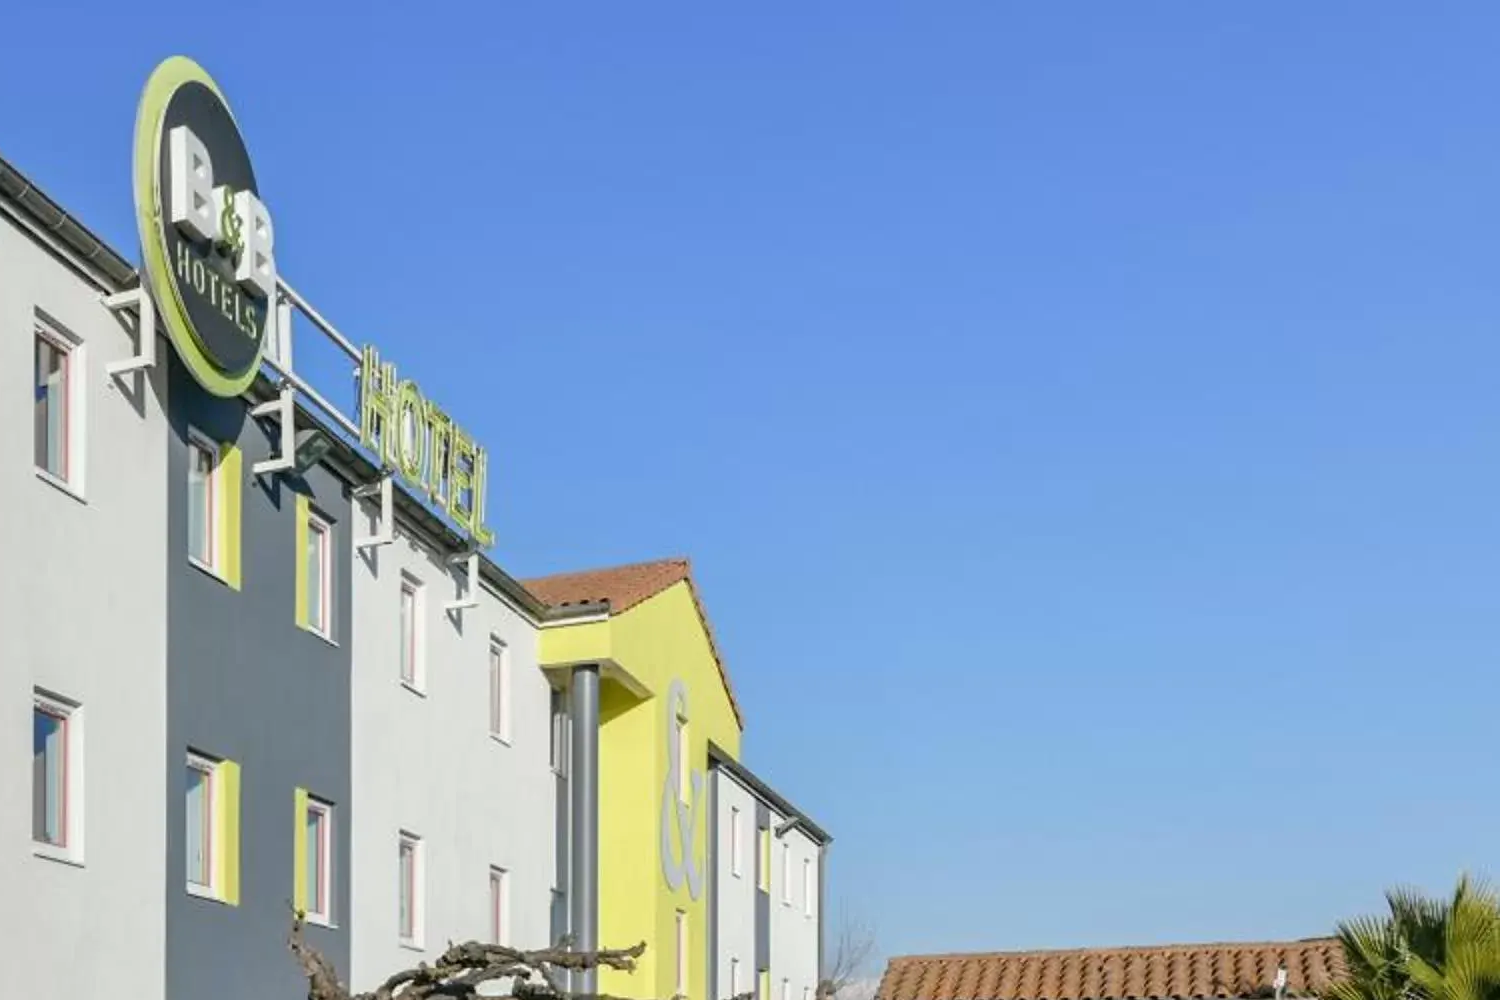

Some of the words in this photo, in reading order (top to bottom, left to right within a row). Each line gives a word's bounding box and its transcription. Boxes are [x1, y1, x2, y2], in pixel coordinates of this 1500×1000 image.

[170, 124, 275, 298] B&B
[176, 239, 257, 339] HOTELS
[361, 343, 494, 546] HOTEL
